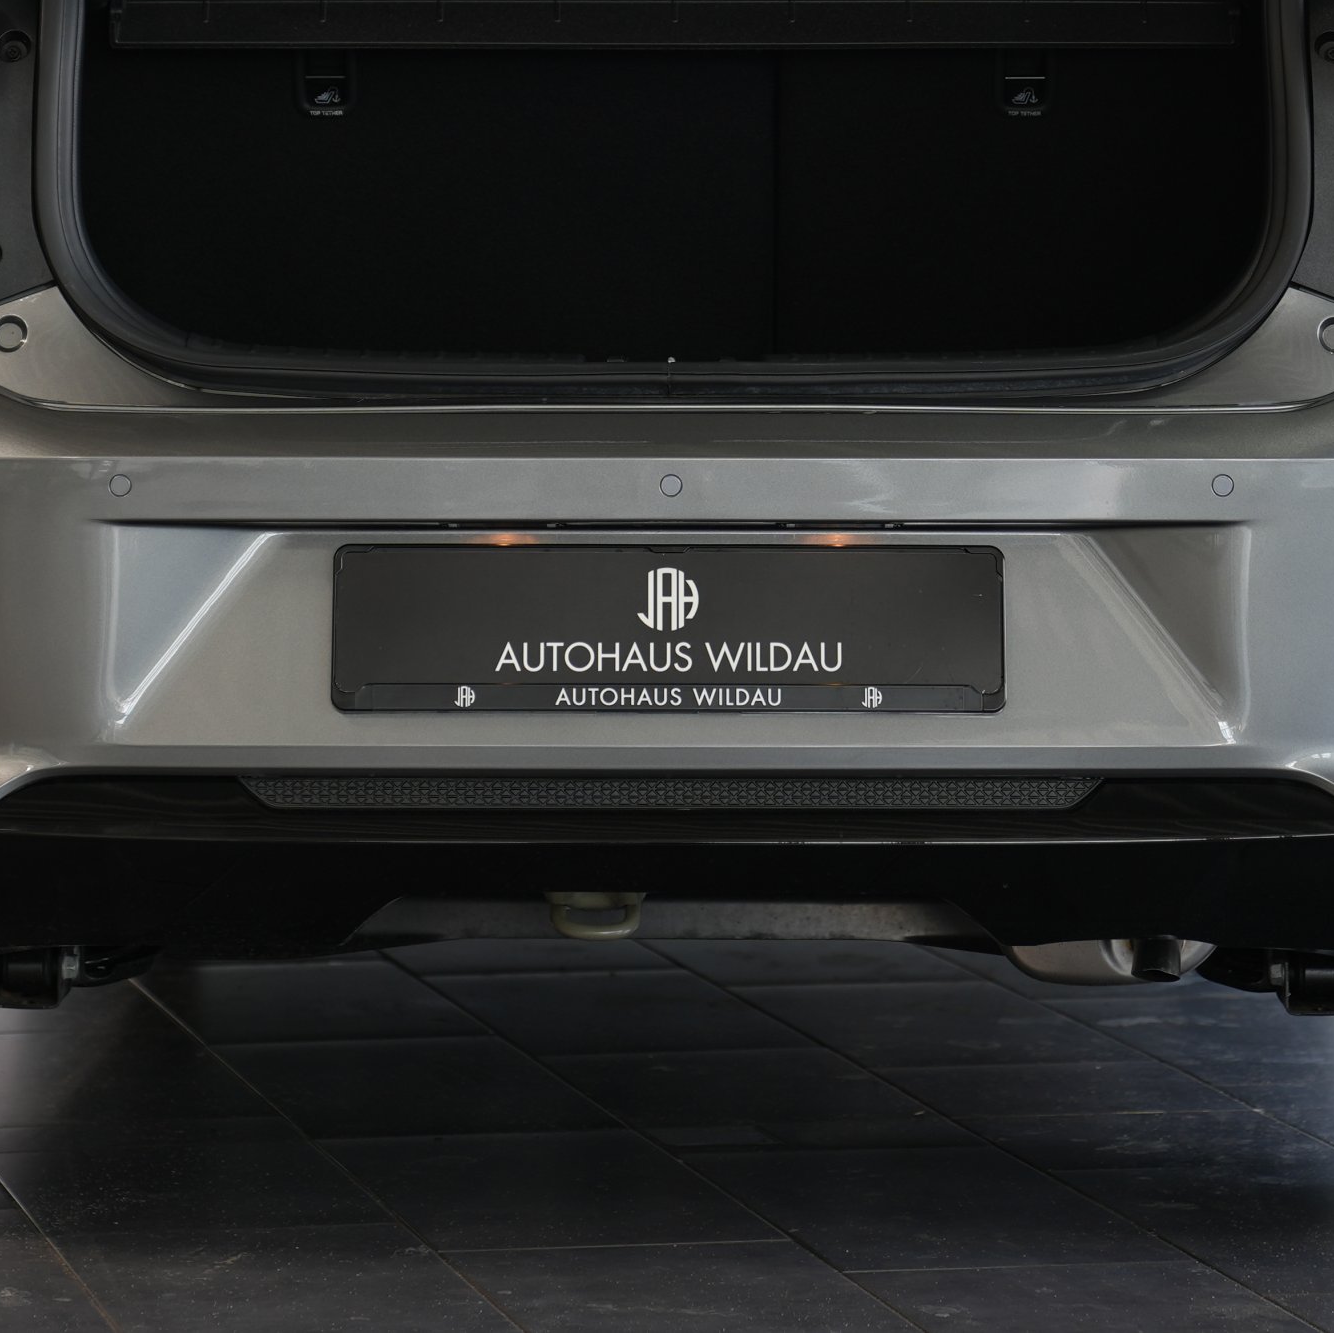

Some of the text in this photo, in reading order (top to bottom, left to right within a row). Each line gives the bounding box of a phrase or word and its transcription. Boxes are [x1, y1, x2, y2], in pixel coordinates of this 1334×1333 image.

[495, 641, 843, 673] AUTOHAUS WILDAU
[555, 687, 782, 707] AUTOHAUS WILDAU
